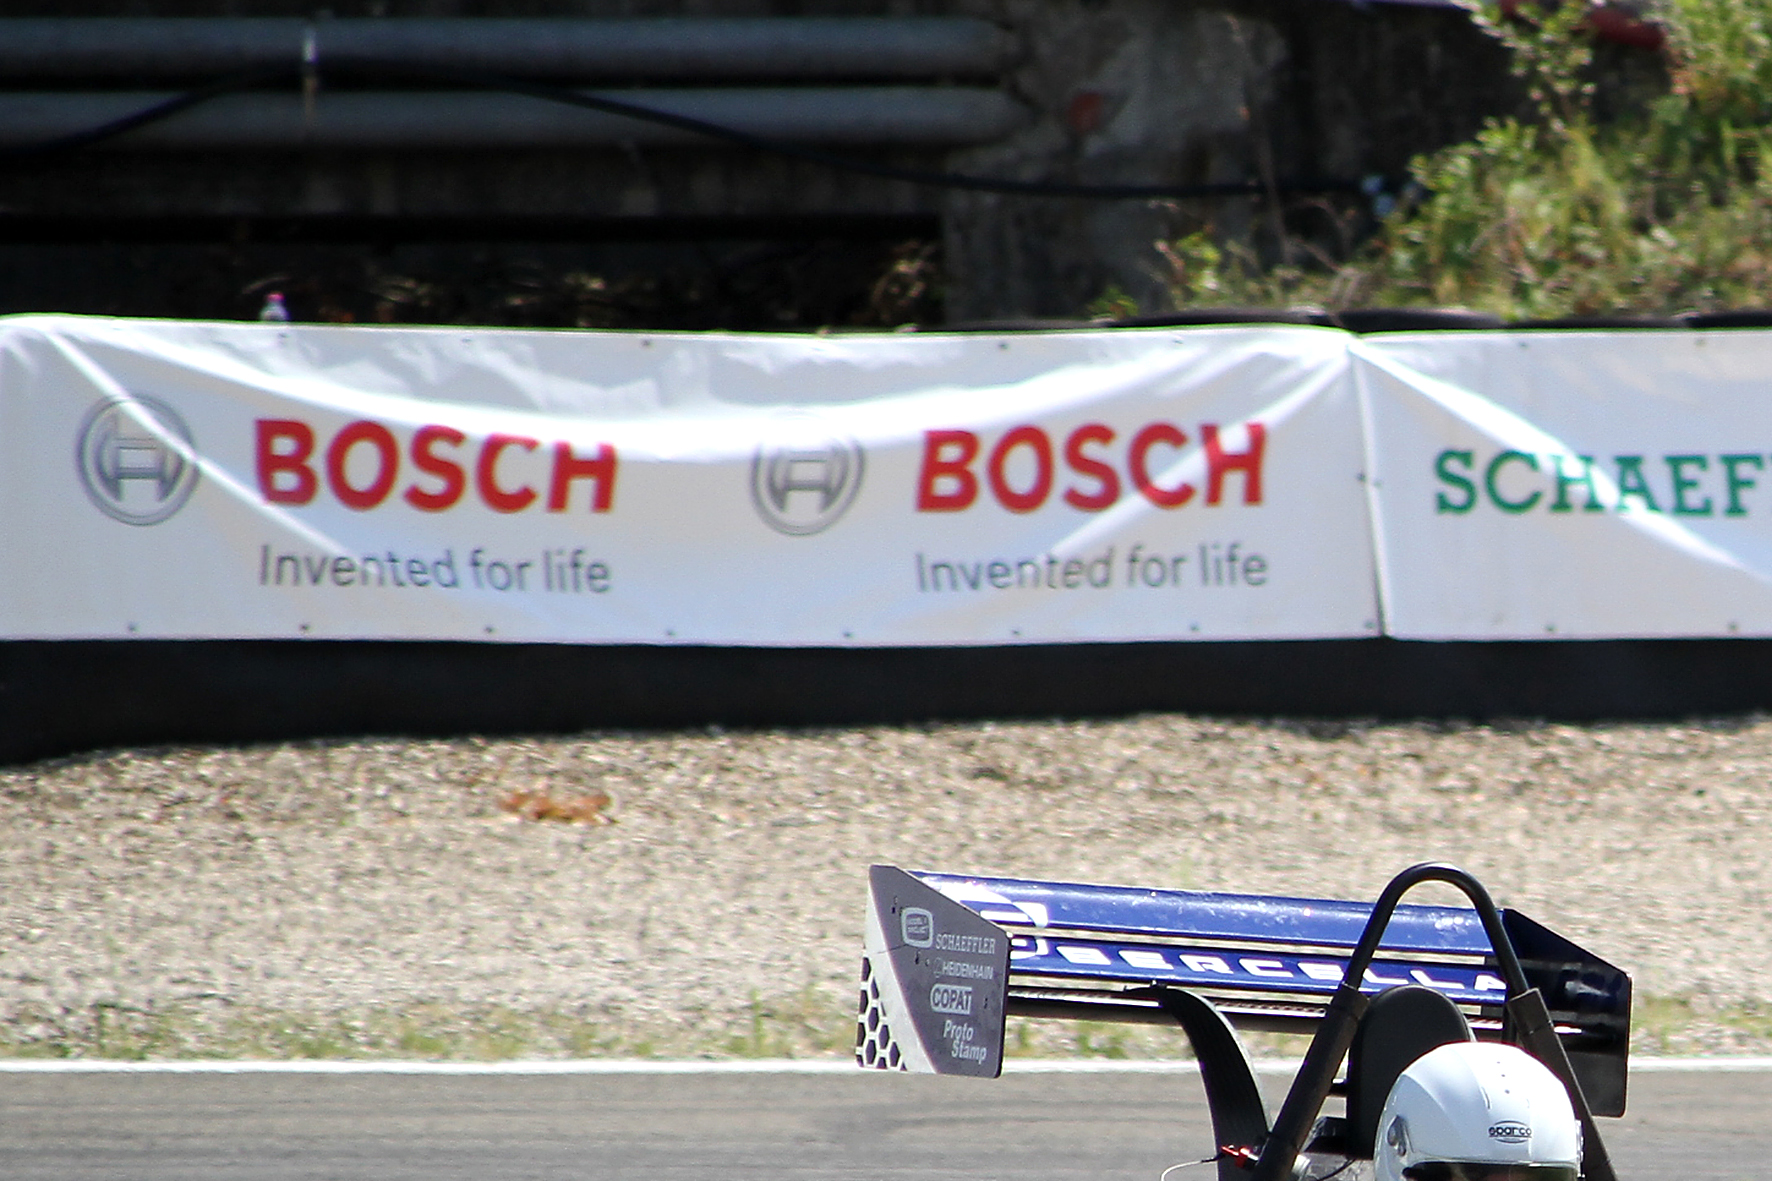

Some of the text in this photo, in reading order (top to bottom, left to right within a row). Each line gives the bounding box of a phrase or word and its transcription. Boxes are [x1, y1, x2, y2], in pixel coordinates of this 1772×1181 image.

[255, 419, 618, 514] BOSCH
[915, 422, 1266, 514] BOSCH
[259, 544, 614, 594] Invented for life
[915, 542, 1268, 593] Invented for life
[935, 933, 996, 955] SCHAEFFLER
[942, 961, 994, 980] HEIDENHAIN
[1056, 945, 1507, 991] BERCELLA
[943, 1019, 974, 1041] Proto
[951, 1039, 987, 1065] Stamp
